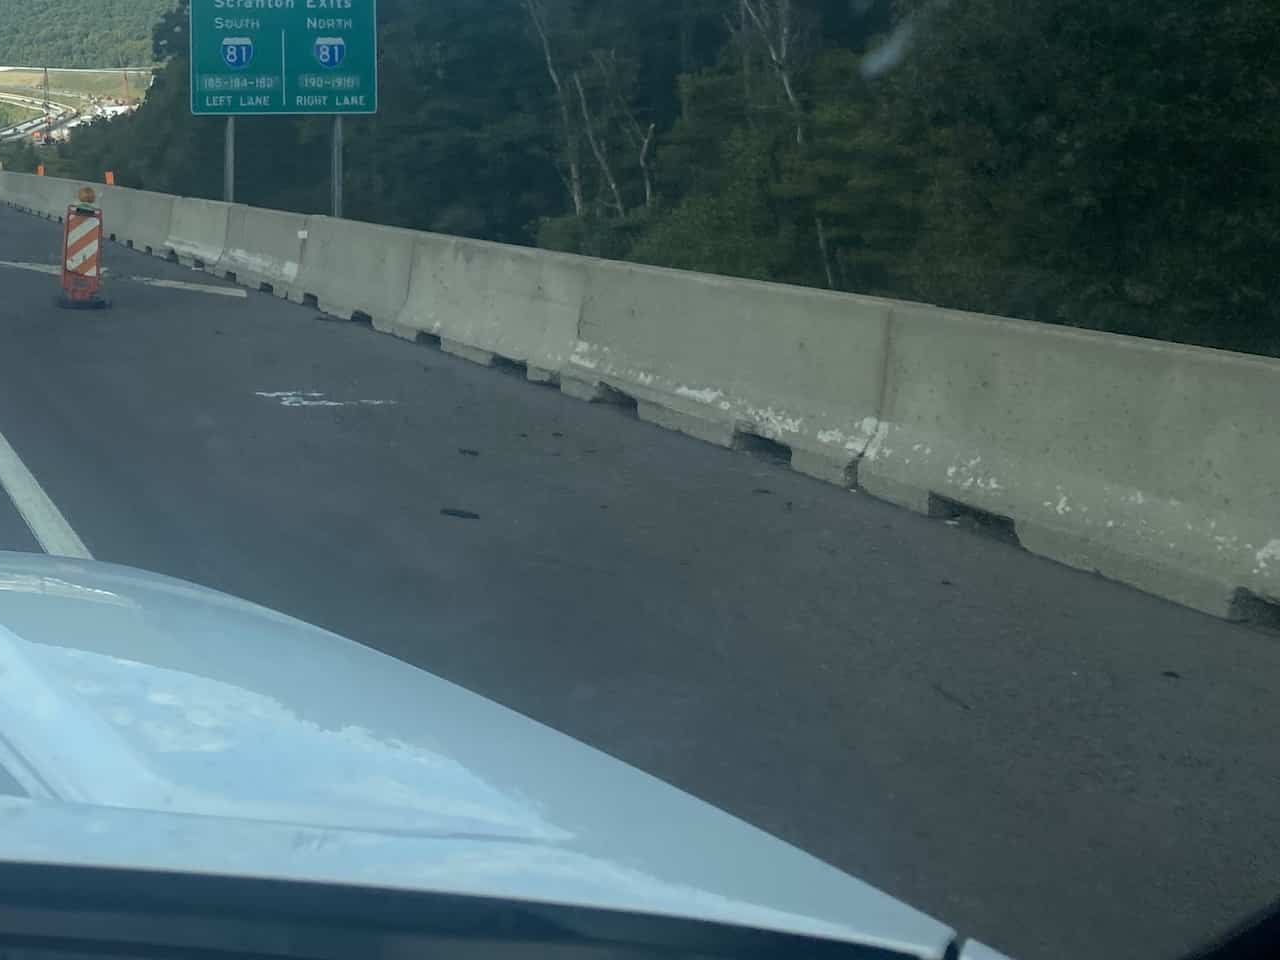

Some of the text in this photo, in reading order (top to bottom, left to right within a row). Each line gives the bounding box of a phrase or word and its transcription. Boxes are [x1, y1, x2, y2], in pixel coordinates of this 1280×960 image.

[214, 17, 260, 29] SOUTH
[306, 17, 353, 29] NORTH
[226, 46, 247, 63] 81
[319, 46, 340, 63] 81
[205, 95, 271, 106] LEFT LANE
[296, 95, 366, 106] RIGHT LANE
